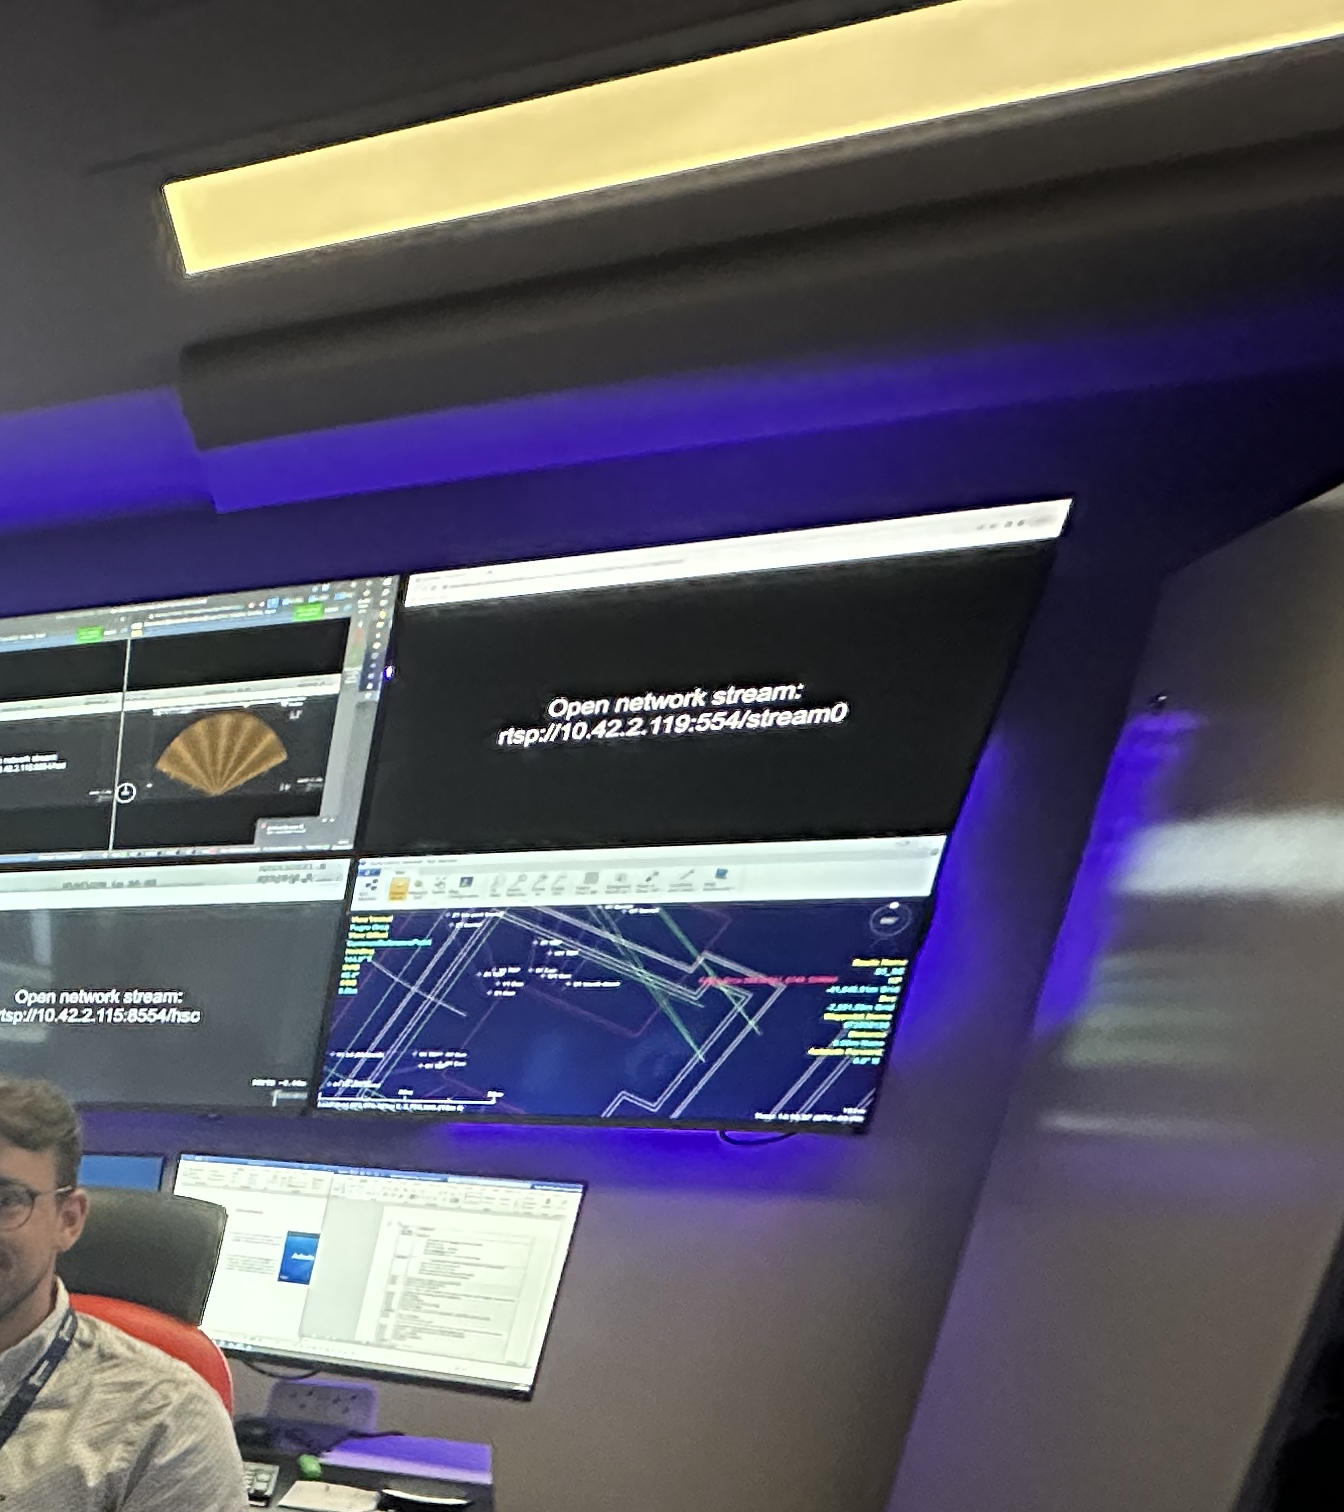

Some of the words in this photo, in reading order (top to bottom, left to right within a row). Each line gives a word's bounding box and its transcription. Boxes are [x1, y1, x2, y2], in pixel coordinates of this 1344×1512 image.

[548, 697, 610, 722] Open
[615, 688, 707, 712] network
[712, 683, 805, 705] stream:
[497, 702, 849, 748] rtsp://10.42.2.119:554/stream0
[14, 988, 56, 1007] Open
[59, 988, 121, 1005] network
[123, 989, 184, 1004] stream:
